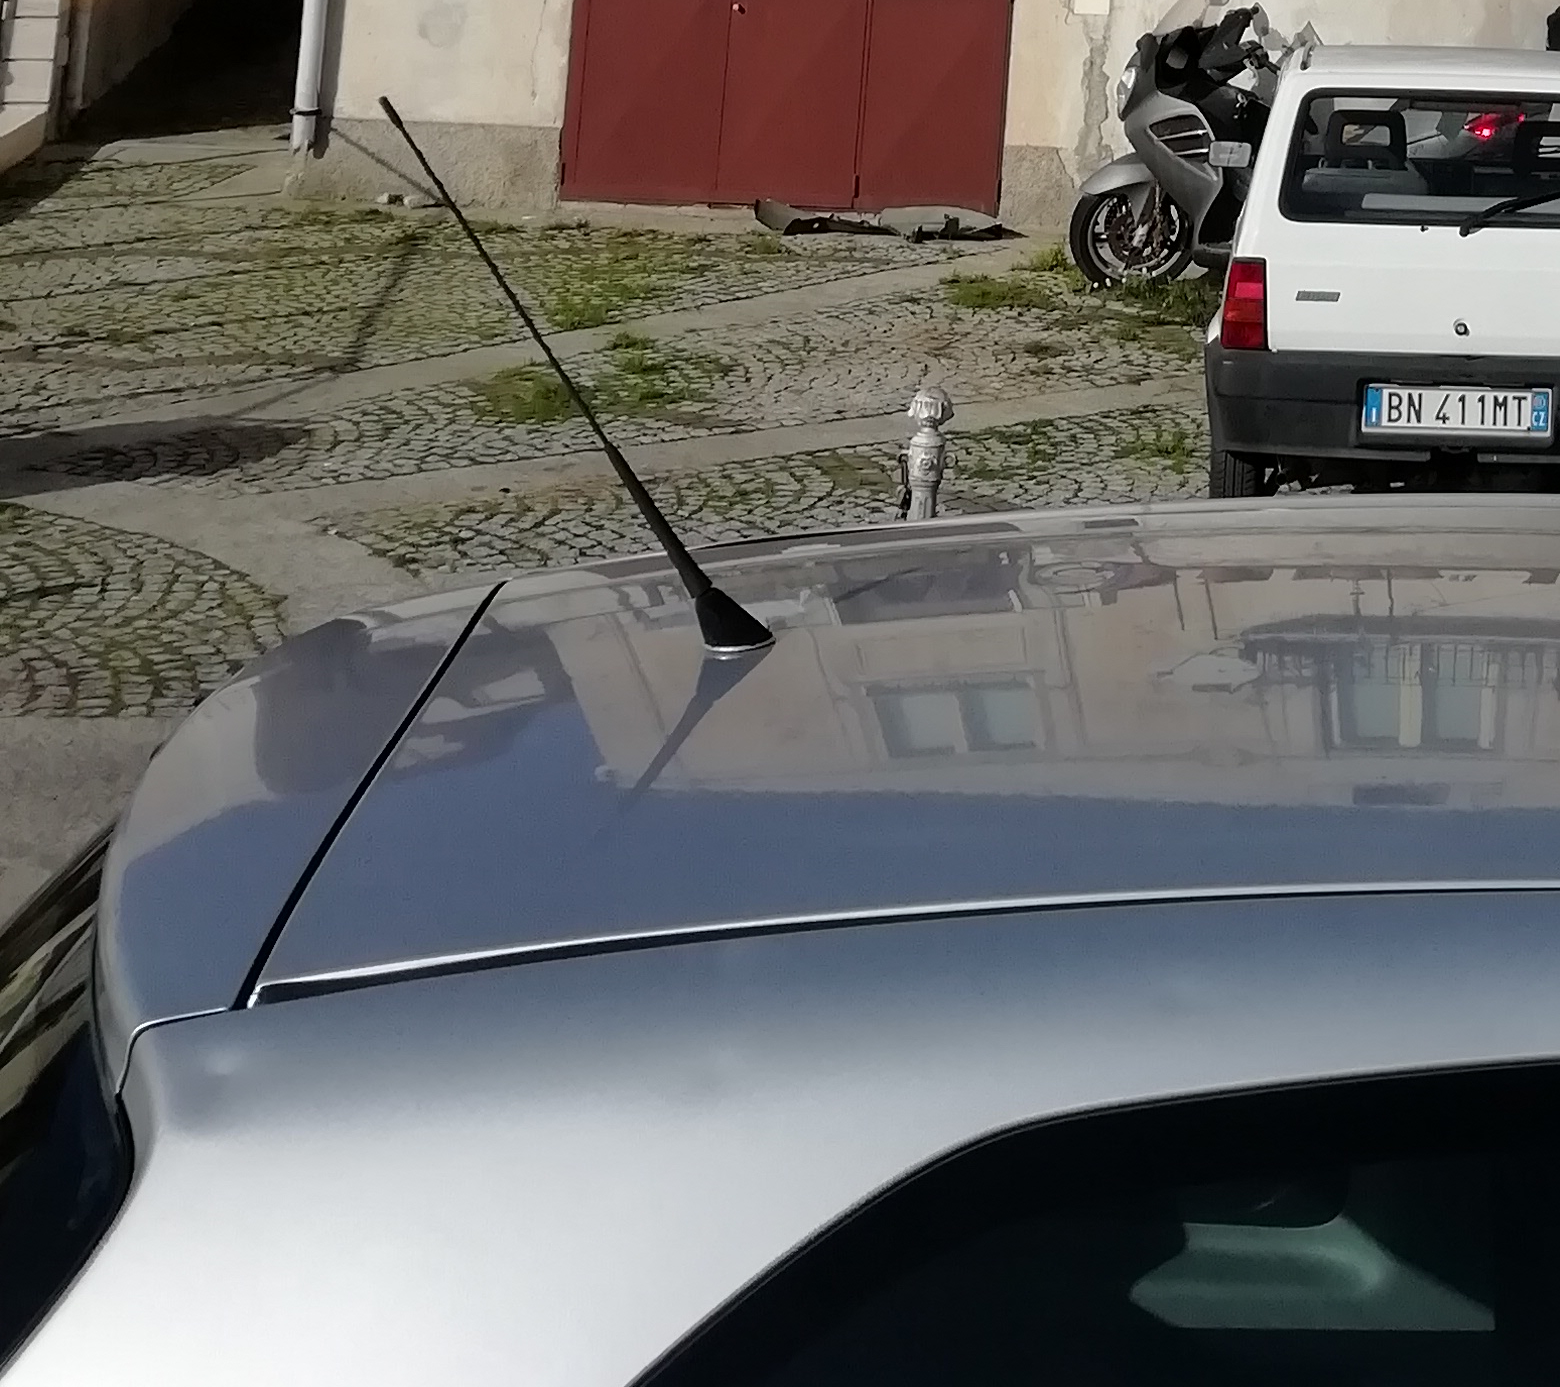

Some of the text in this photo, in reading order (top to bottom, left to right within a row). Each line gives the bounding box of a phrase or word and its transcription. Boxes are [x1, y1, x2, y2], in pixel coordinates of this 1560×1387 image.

[1386, 391, 1423, 424] BN
[1435, 393, 1528, 427] 411MT
[1531, 411, 1547, 427] CZ
